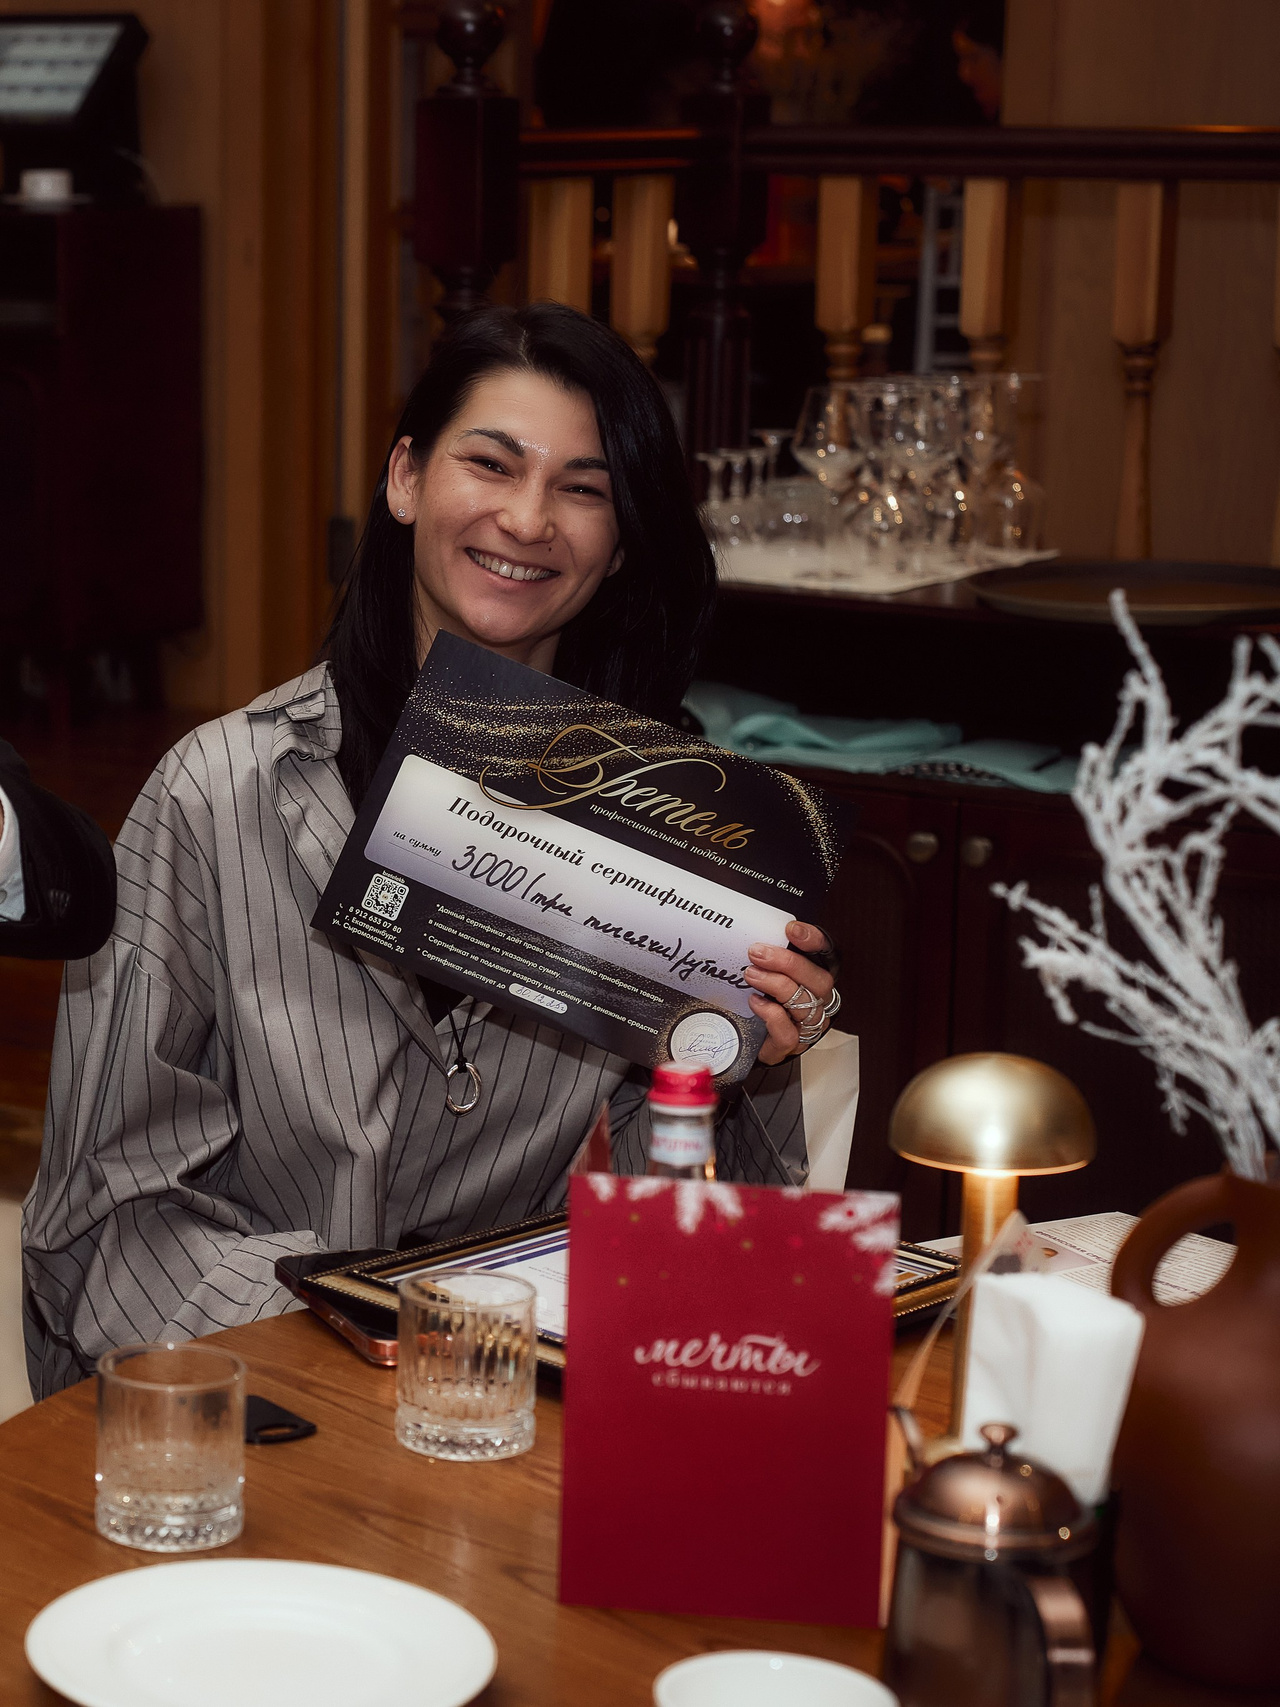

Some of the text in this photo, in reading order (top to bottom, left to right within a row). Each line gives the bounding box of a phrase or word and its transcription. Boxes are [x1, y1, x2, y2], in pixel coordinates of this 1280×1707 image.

[479, 724, 755, 851] Бретель
[393, 830, 442, 857] на сумму
[447, 796, 734, 929] Подарочный сертификат
[590, 803, 804, 897] профессиональный подбор нижнего белья
[343, 923, 393, 950] Сыромолотова,
[352, 917, 397, 942] Екатеринбург,
[356, 909, 368, 918] 912
[369, 916, 381, 924] 633
[422, 950, 463, 971] Сертификат
[463, 970, 496, 985] действует
[434, 922, 457, 934] нашем
[458, 932, 490, 948] магазине
[501, 950, 537, 968] указанную
[466, 918, 506, 937] сертификат
[506, 936, 522, 944] даёт
[523, 942, 544, 953] право
[545, 952, 597, 975] единовременно
[598, 973, 638, 992] приобрести
[640, 990, 664, 1002] товары
[429, 936, 469, 956] Сертификат
[480, 959, 511, 974] подлежит
[512, 972, 542, 988] возврату
[556, 990, 582, 1004] обмену
[592, 1005, 626, 1021] денежные
[628, 1020, 658, 1034] средства
[633, 1331, 821, 1377] мечты
